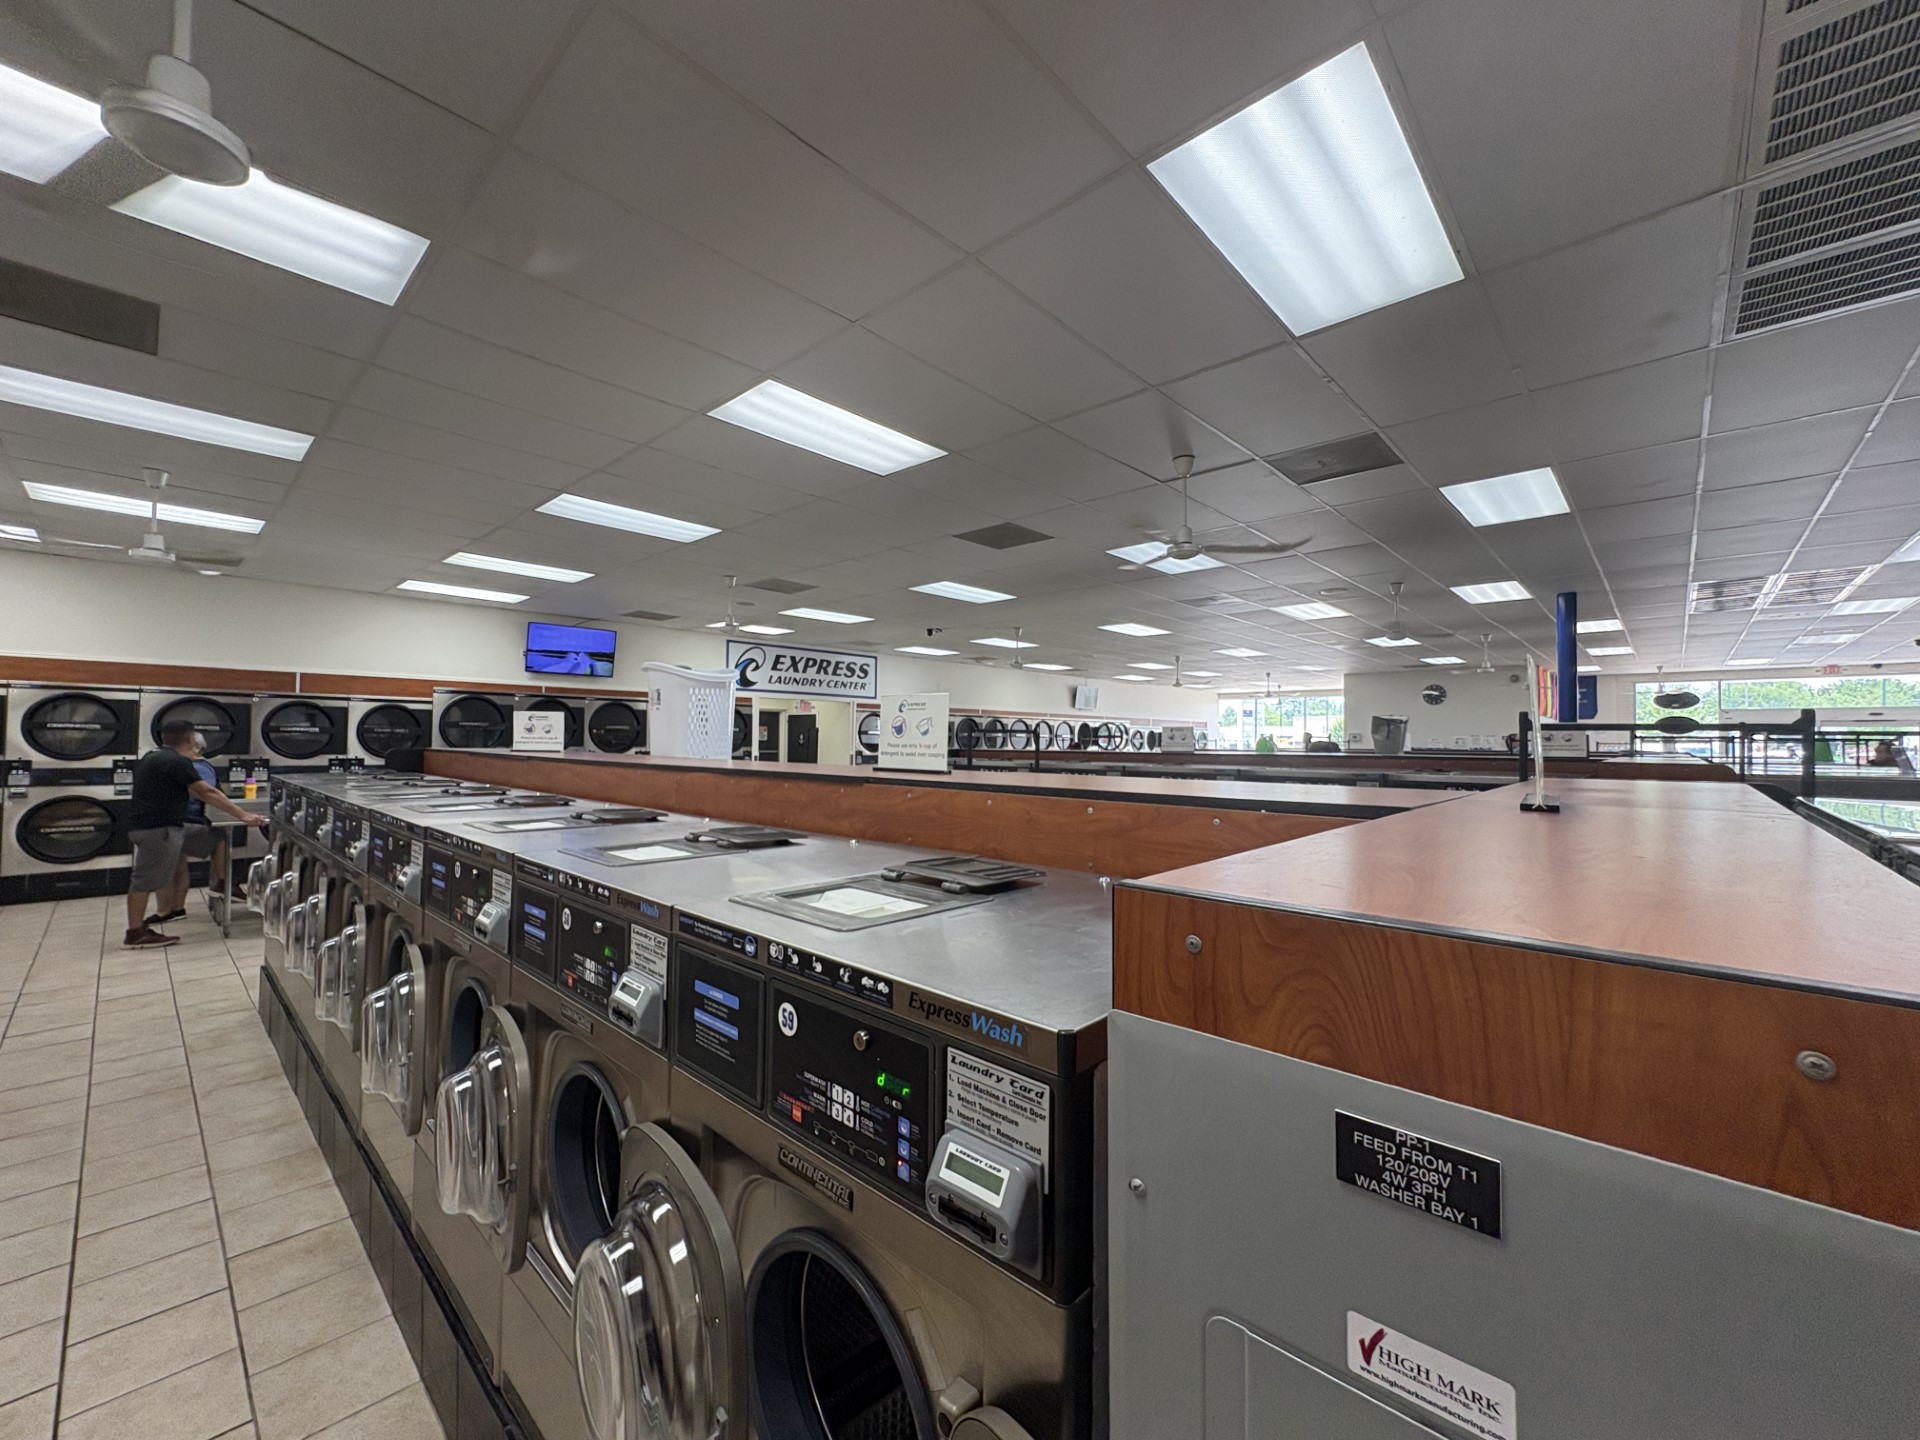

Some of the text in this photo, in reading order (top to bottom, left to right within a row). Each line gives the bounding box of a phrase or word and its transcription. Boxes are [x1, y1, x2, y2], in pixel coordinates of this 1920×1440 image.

[768, 674, 868, 691] LAUNDRY CENTER
[770, 653, 871, 680] EXPRESS
[781, 1007, 794, 1032] 59
[908, 991, 1023, 1048] ExpressWash
[948, 1074, 1046, 1121] 1. Load Machine & Close Door
[950, 1054, 1045, 1100] Laundry Card
[948, 1090, 954, 1098] 2.
[957, 1093, 977, 1108] Select
[978, 1102, 1019, 1128] Temperature
[948, 1106, 954, 1114] 3.
[957, 1109, 976, 1124] Insert
[976, 1118, 992, 1132] Card
[996, 1127, 1023, 1147] Remove
[1024, 1140, 1042, 1156] Card
[955, 1147, 1002, 1174] LAUNDRY CARD
[1354, 1131, 1478, 1184] FEED FROM T1
[1396, 1130, 1430, 1153] PP-1
[780, 1148, 850, 1202] CONTINENTAL
[1376, 1154, 1450, 1189] 120/208V
[1382, 1171, 1446, 1204] 4W 3PH
[1354, 1172, 1478, 1230] WASHER BAY 1
[1378, 1344, 1502, 1417] HIGH MARK
[1378, 1358, 1474, 1412] Manufacturing
